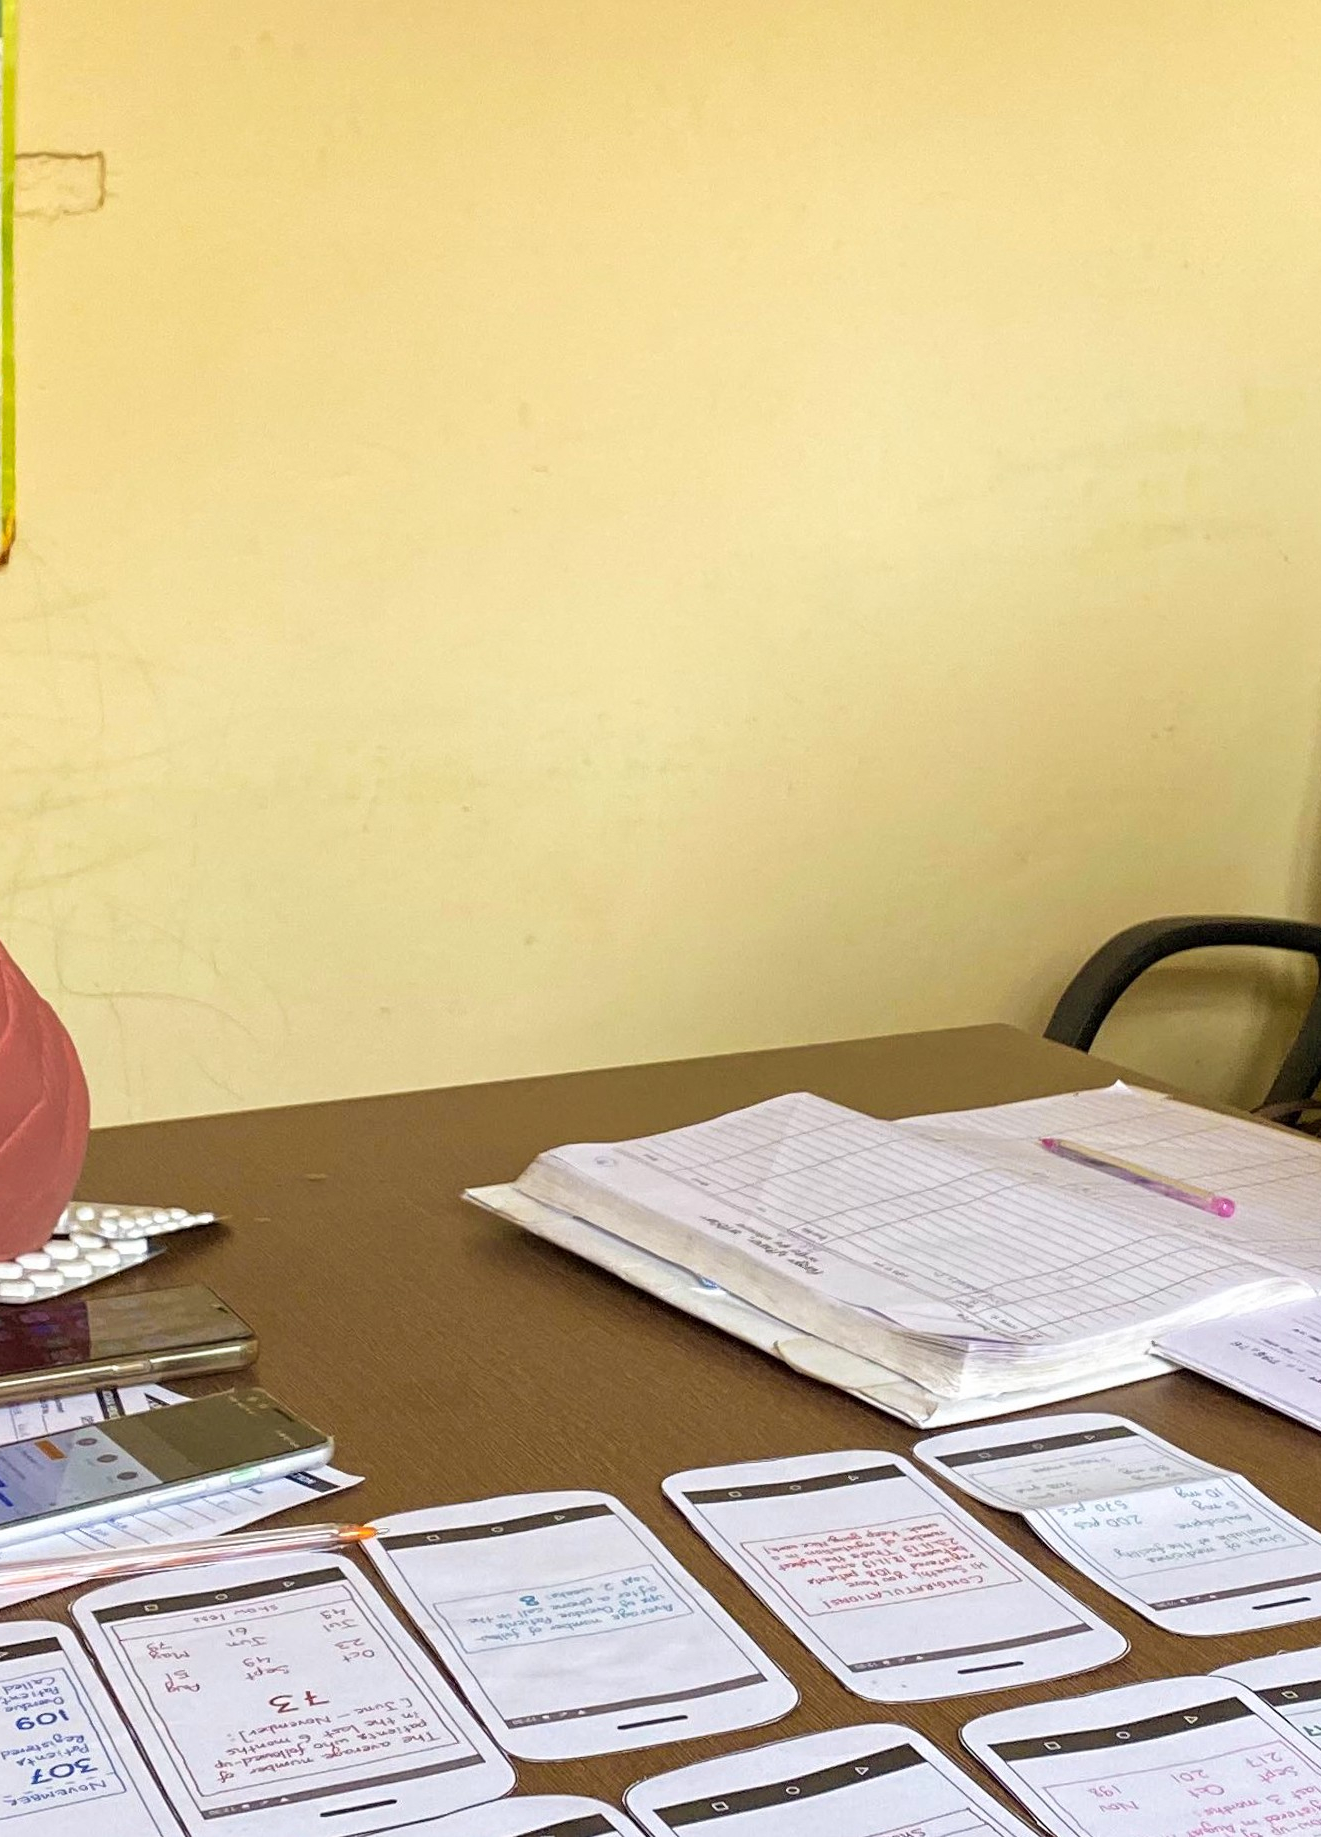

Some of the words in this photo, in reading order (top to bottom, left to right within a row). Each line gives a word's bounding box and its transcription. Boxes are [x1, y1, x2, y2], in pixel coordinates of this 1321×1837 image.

[520, 1596, 539, 1606] 8
[228, 1627, 247, 1636] 61
[323, 1619, 358, 1632] Jul
[226, 1637, 266, 1647] Jun
[335, 1638, 364, 1649] 23
[149, 1647, 190, 1659] May
[343, 1650, 375, 1662] Oct
[247, 1665, 289, 1680] Sept
[2, 1677, 55, 1695] Called
[165, 1676, 200, 1693] Aug
[269, 1691, 329, 1713] 73
[16, 1709, 69, 1730] 109
[365, 1717, 395, 1726] the
[324, 1725, 360, 1738] last
[355, 1717, 427, 1740] patients
[313, 1738, 349, 1749] who
[402, 1732, 440, 1743] The
[226, 1738, 291, 1755] months
[314, 1732, 391, 1759] average
[16, 1743, 89, 1766] Patients
[1246, 1752, 1283, 1768] 217
[31, 1758, 97, 1785] 307
[250, 1758, 314, 1774] number
[218, 1771, 234, 1783] of
[1171, 1769, 1209, 1783] 201
[1259, 1766, 1298, 1783] Sept
[1188, 1784, 1225, 1798] Oct
[1099, 1801, 1139, 1812] Nov
[1266, 1794, 1285, 1805] 3
